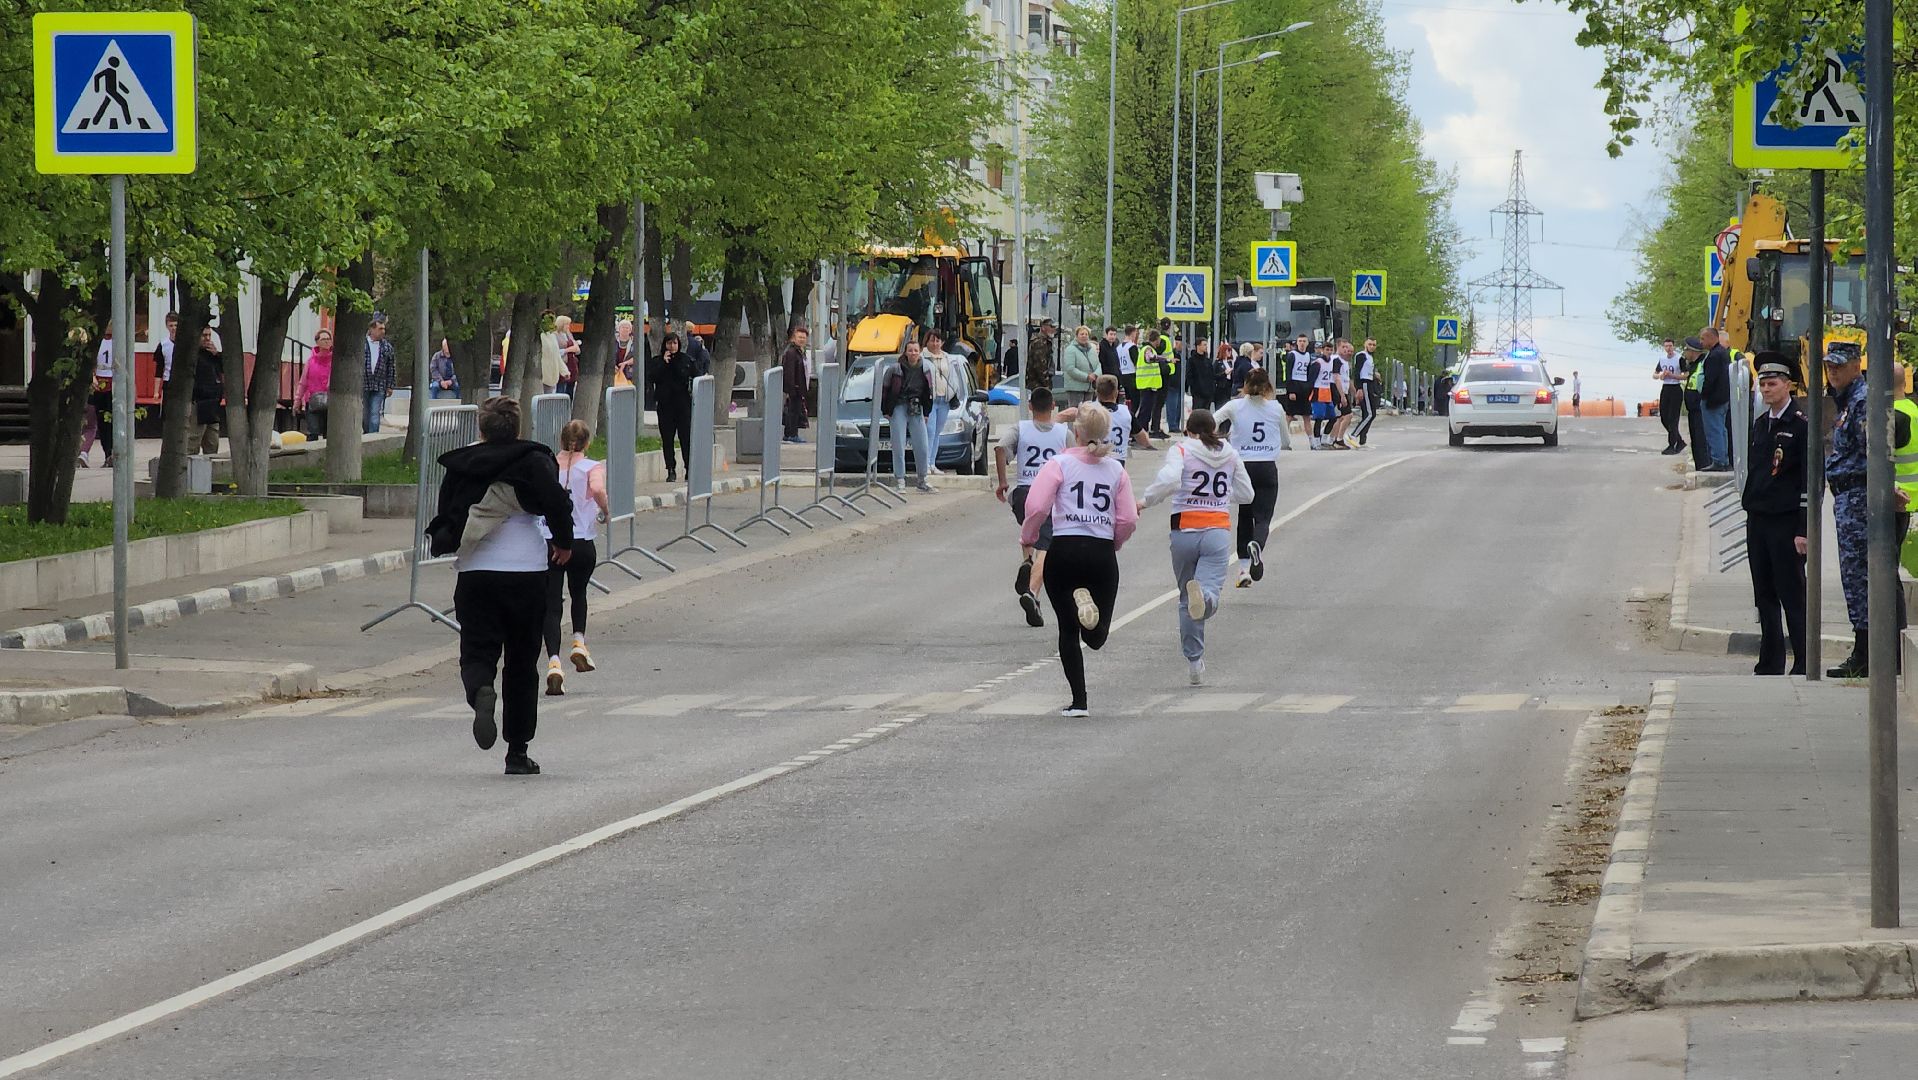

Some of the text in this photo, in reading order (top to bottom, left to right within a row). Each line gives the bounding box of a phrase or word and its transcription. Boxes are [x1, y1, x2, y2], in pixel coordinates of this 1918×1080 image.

[1251, 421, 1266, 443] 5
[1024, 445, 1056, 467] 29
[1240, 444, 1275, 452] КАШИРА
[1191, 470, 1228, 498] 26
[1070, 480, 1111, 512] 15
[1065, 513, 1112, 526] КАШИРА
